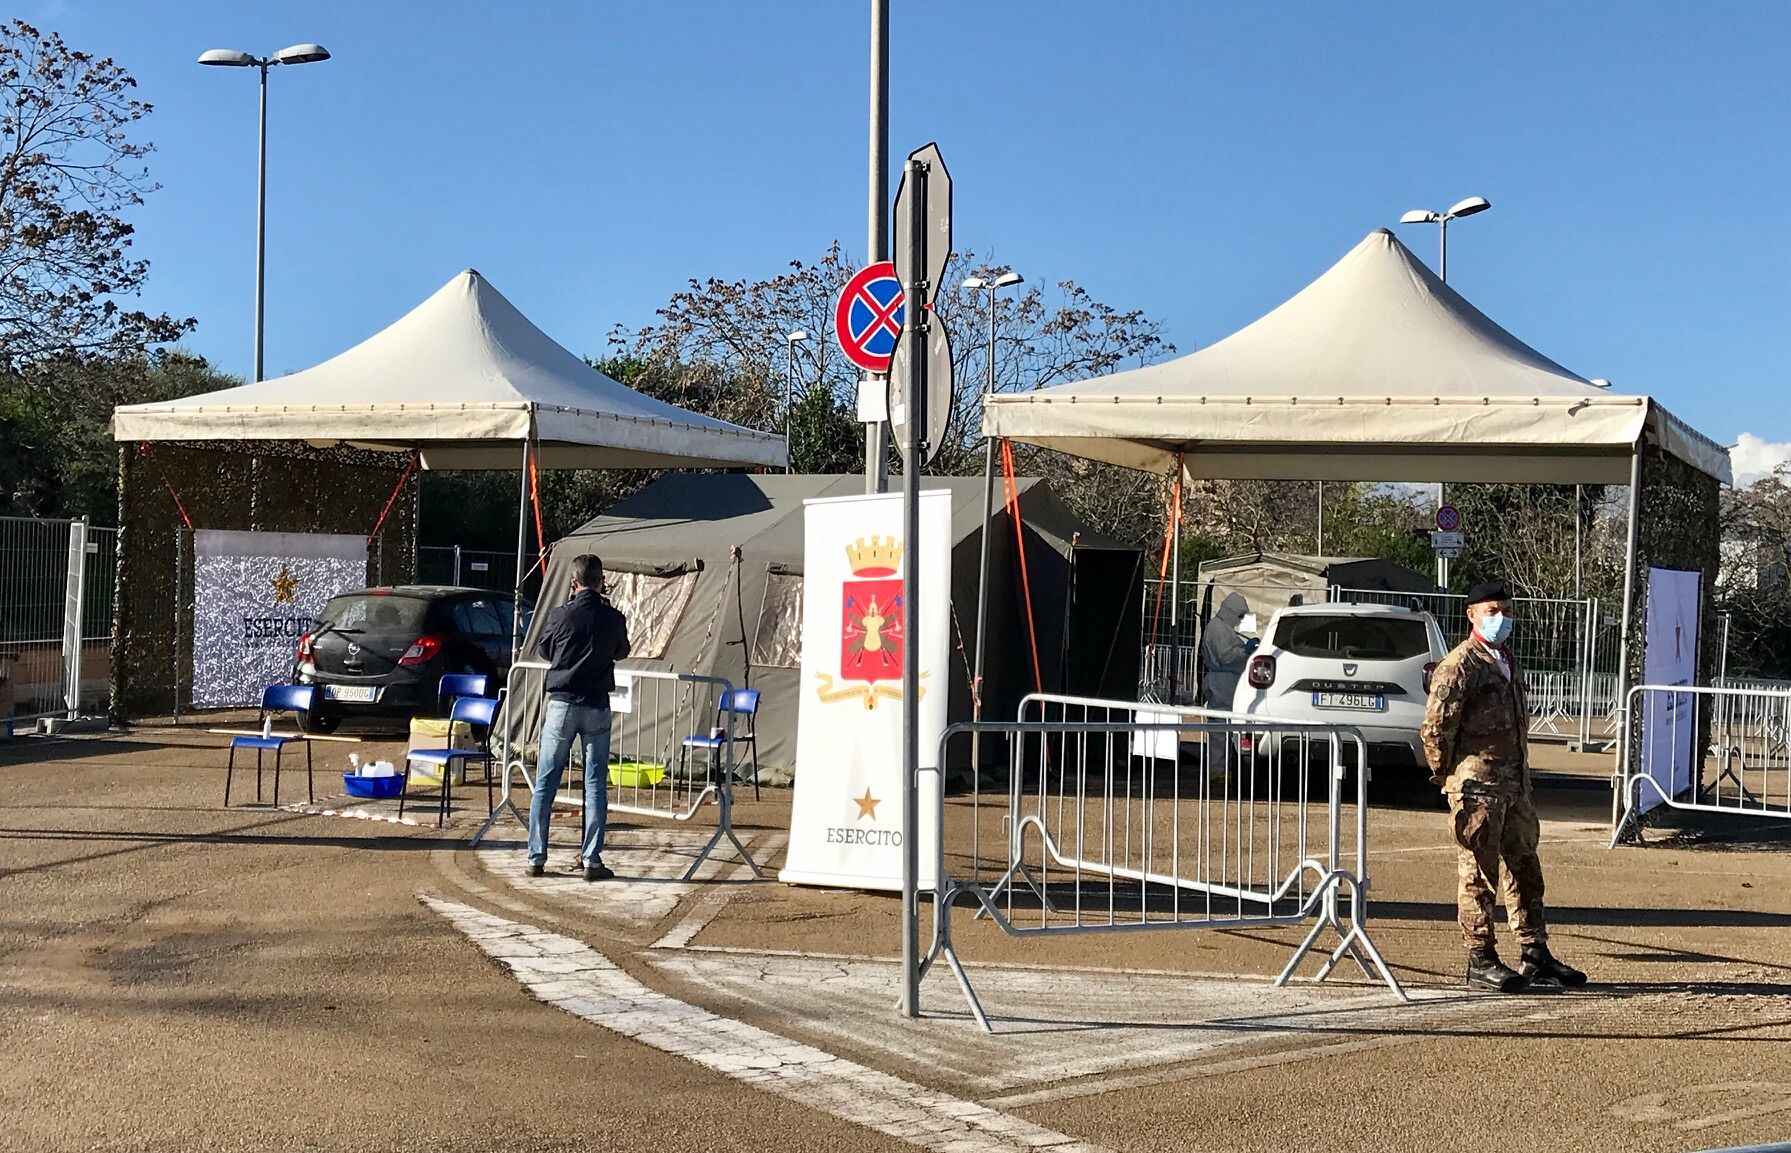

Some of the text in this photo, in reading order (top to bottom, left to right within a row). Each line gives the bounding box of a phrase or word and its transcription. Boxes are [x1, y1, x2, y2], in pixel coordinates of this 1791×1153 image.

[243, 617, 312, 638] ESERCIT
[1312, 681, 1384, 690] DUSTER
[1320, 693, 1375, 707] FT 496LG
[826, 827, 903, 846] ESERCITO
